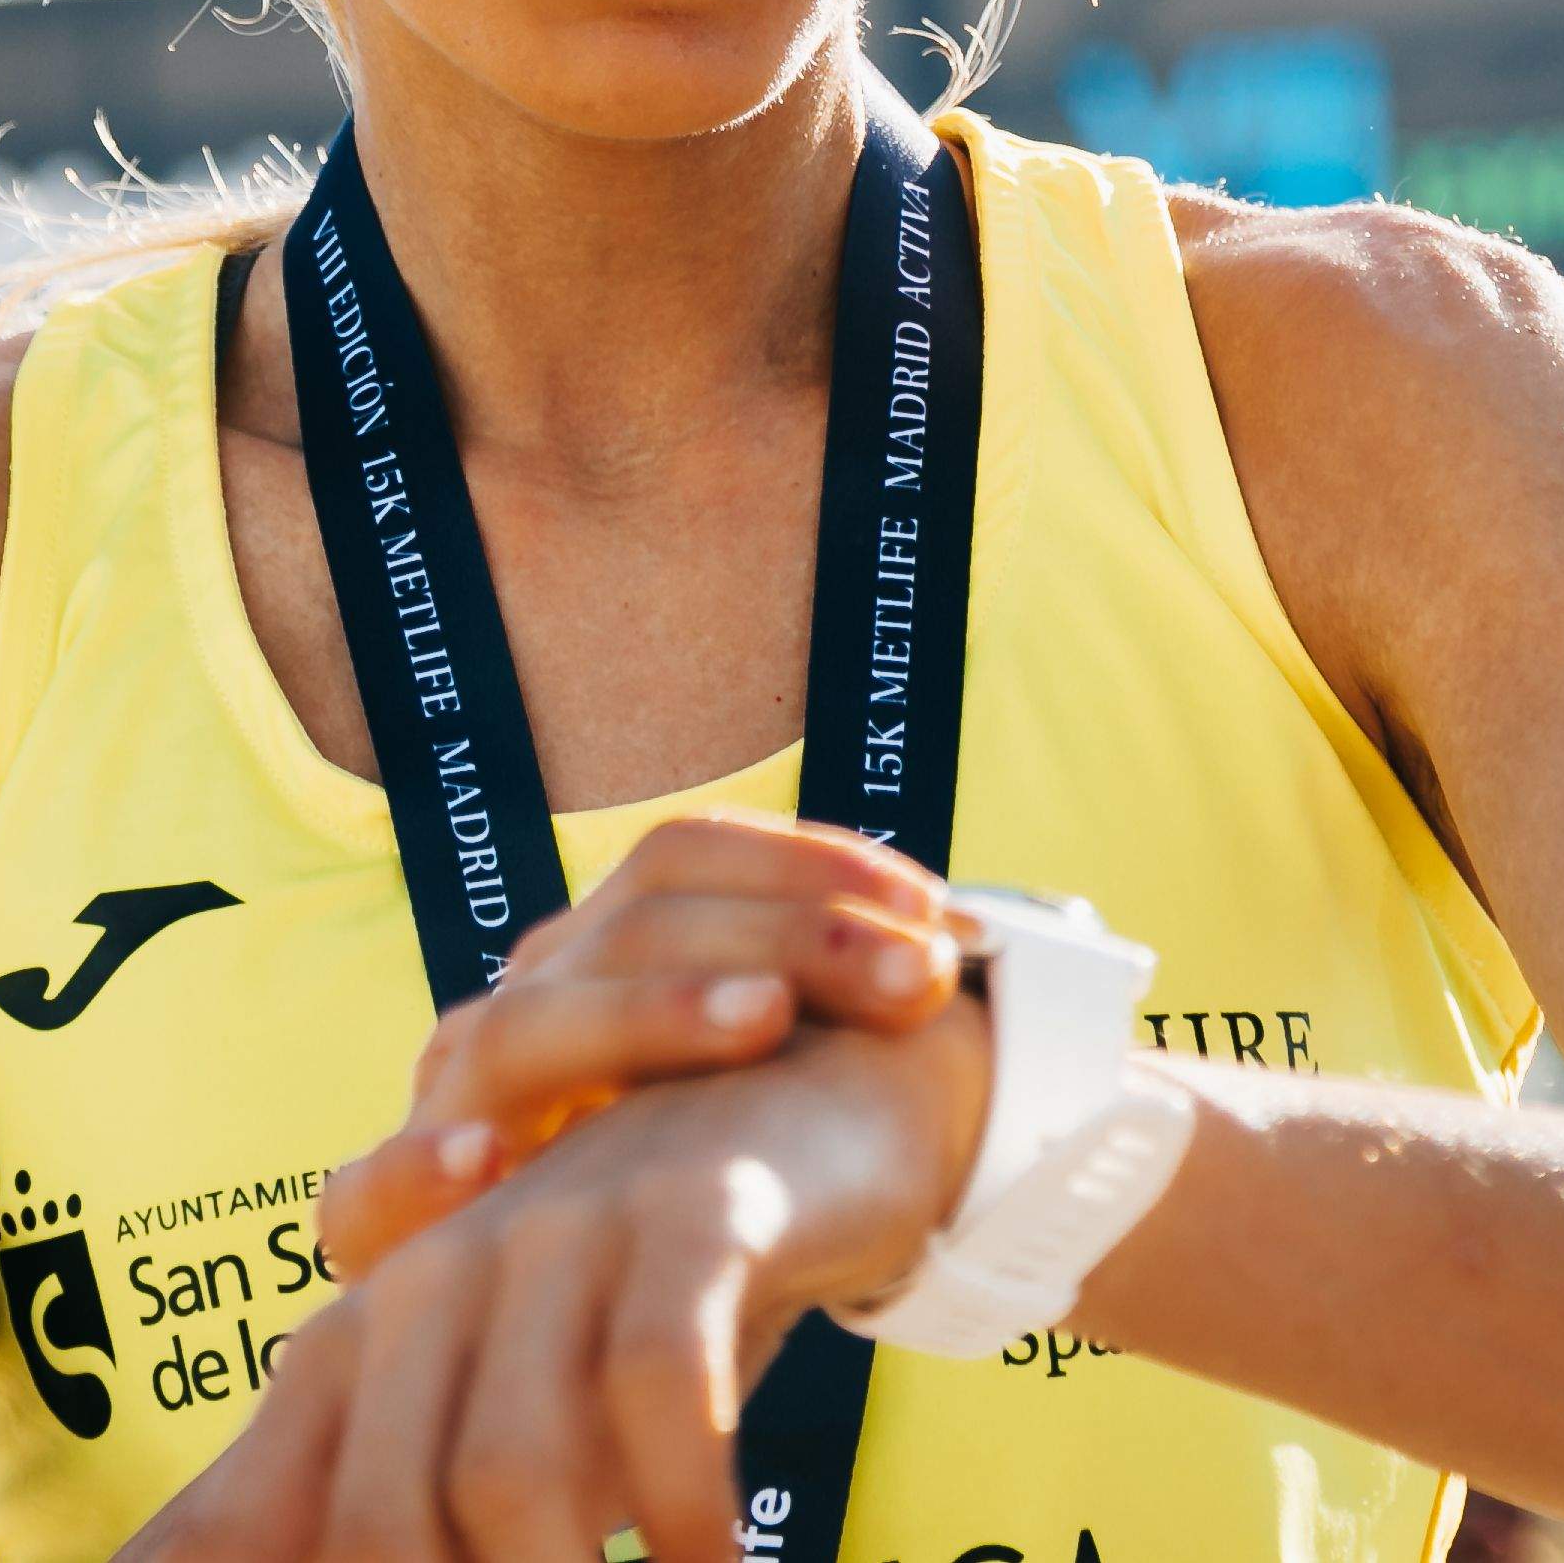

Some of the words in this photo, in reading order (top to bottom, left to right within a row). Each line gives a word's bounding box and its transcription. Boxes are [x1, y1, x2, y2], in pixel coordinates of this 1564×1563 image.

[312, 208, 347, 286] VIII
[897, 181, 931, 310] ACTIVA
[328, 281, 394, 437] EDICIÓN
[884, 320, 931, 492] MADRID
[362, 450, 412, 525] 15K
[380, 529, 462, 719] METLIFE
[870, 515, 919, 706] METLIFE
[863, 718, 906, 797] 15K
[432, 736, 511, 930] MADRID
[116, 1168, 332, 1243] AYUNTAMIE
[128, 1253, 254, 1327] San
[152, 1333, 231, 1412] de
